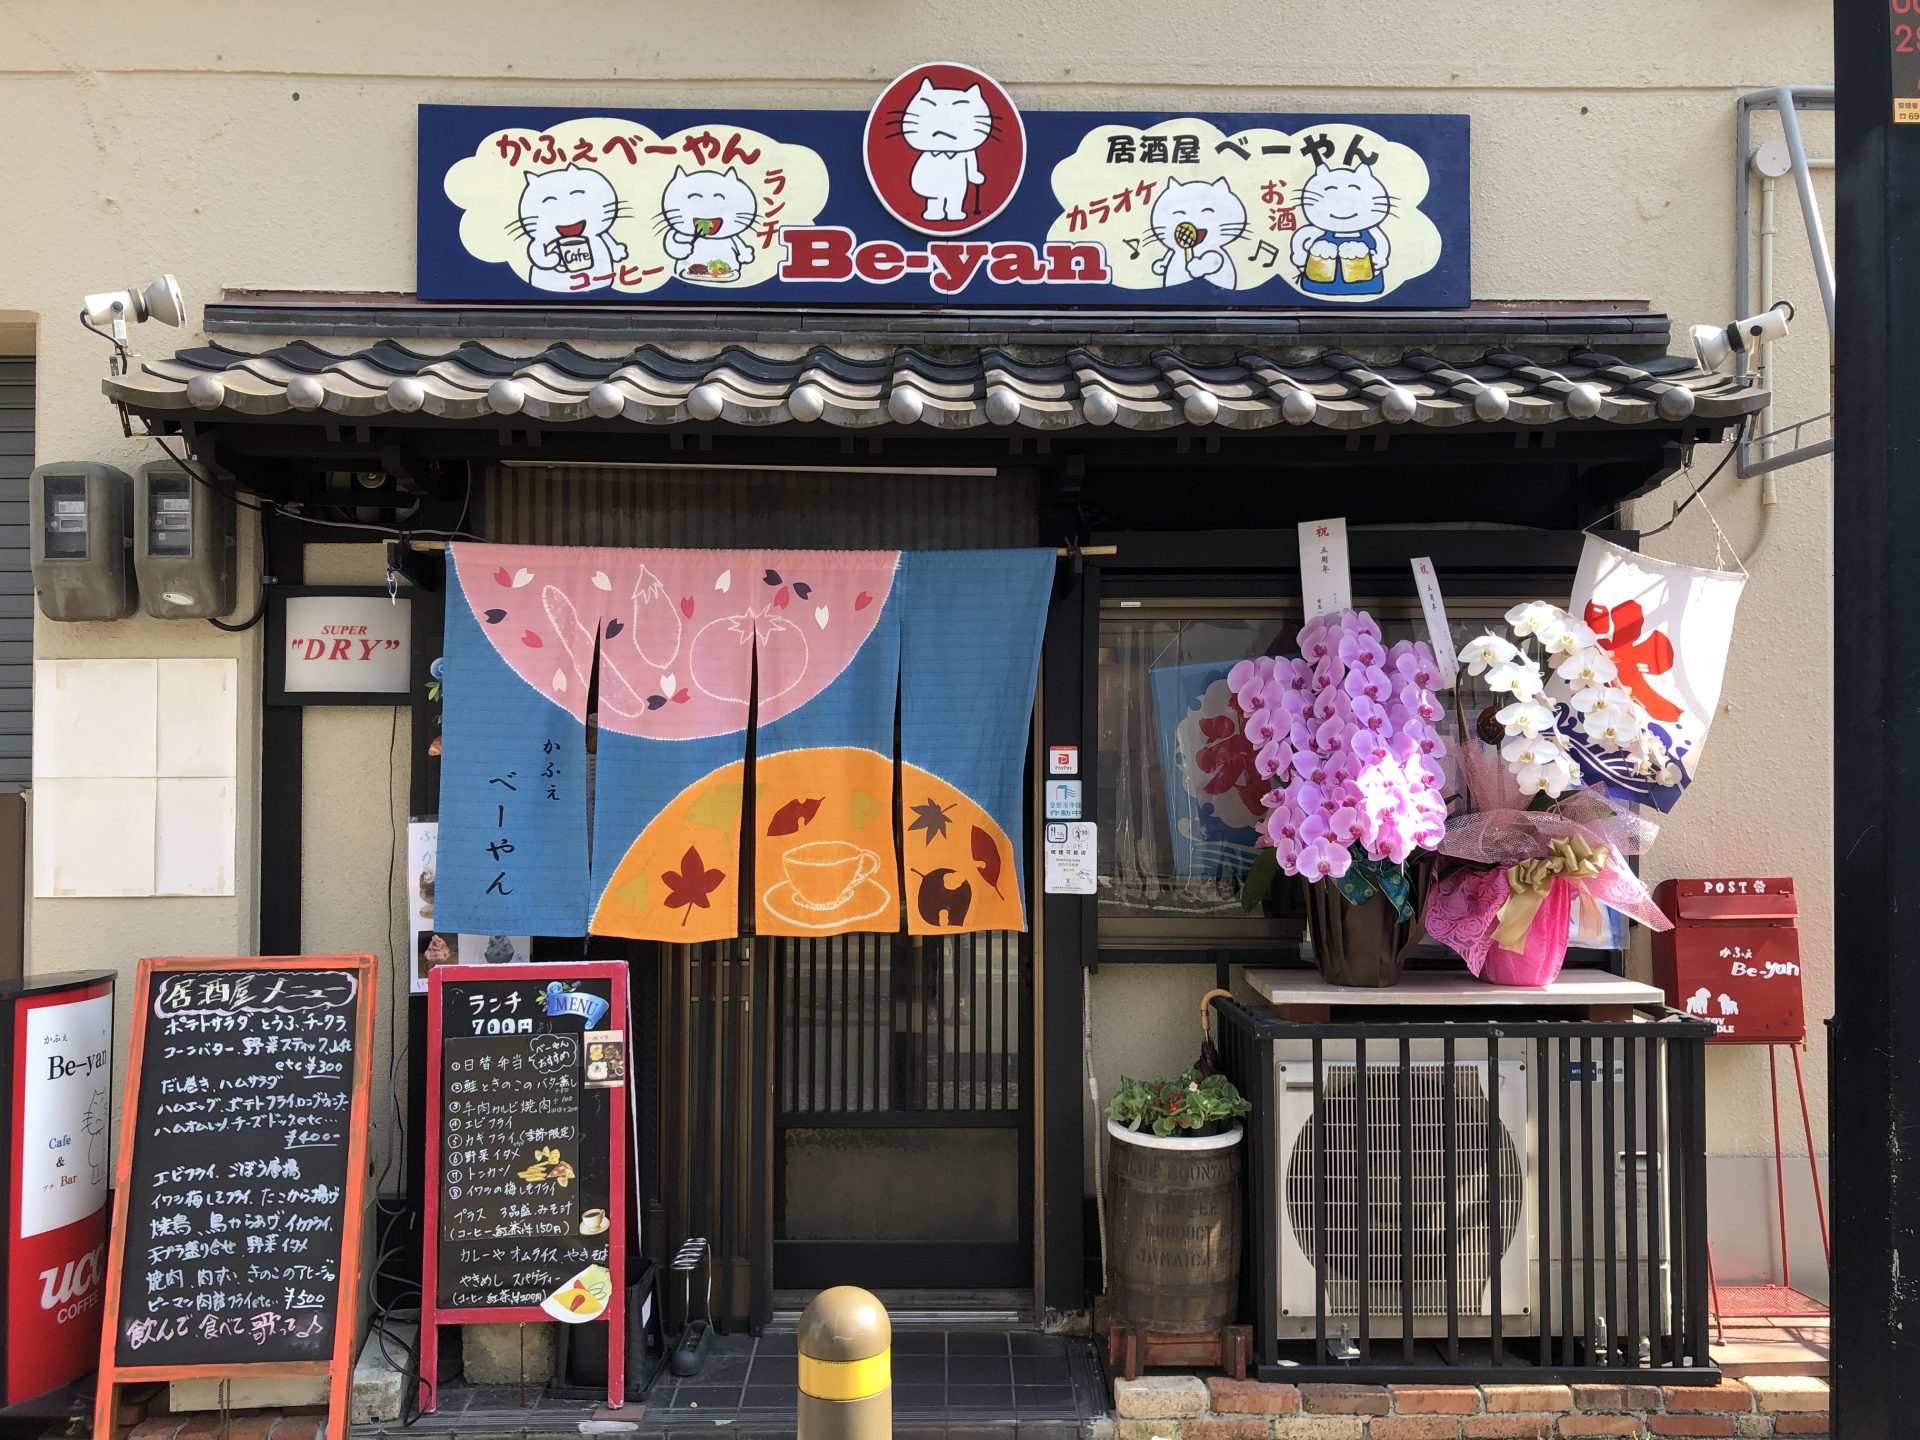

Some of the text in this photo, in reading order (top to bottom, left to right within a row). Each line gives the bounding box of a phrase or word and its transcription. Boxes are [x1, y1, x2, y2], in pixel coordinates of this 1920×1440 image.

[757, 169, 788, 250] ランチ
[1066, 179, 1158, 234] カラオケ
[1261, 180, 1298, 233] お酒
[564, 248, 590, 264] Cafe
[781, 228, 1108, 292] Be-yan
[569, 266, 666, 291] コーヒー
[321, 625, 368, 636] SUPER
[486, 771, 517, 896] べーやん
[1704, 881, 1748, 894] POST
[1731, 961, 1800, 979] Be-yan
[469, 991, 522, 1015] ランチ
[556, 997, 599, 1016] MENU
[472, 1018, 533, 1035] 700円
[47, 1049, 108, 1081] Be-yan
[49, 1135, 72, 1150] Cafe
[56, 1156, 65, 1168] &
[60, 1173, 78, 1187] Bar
